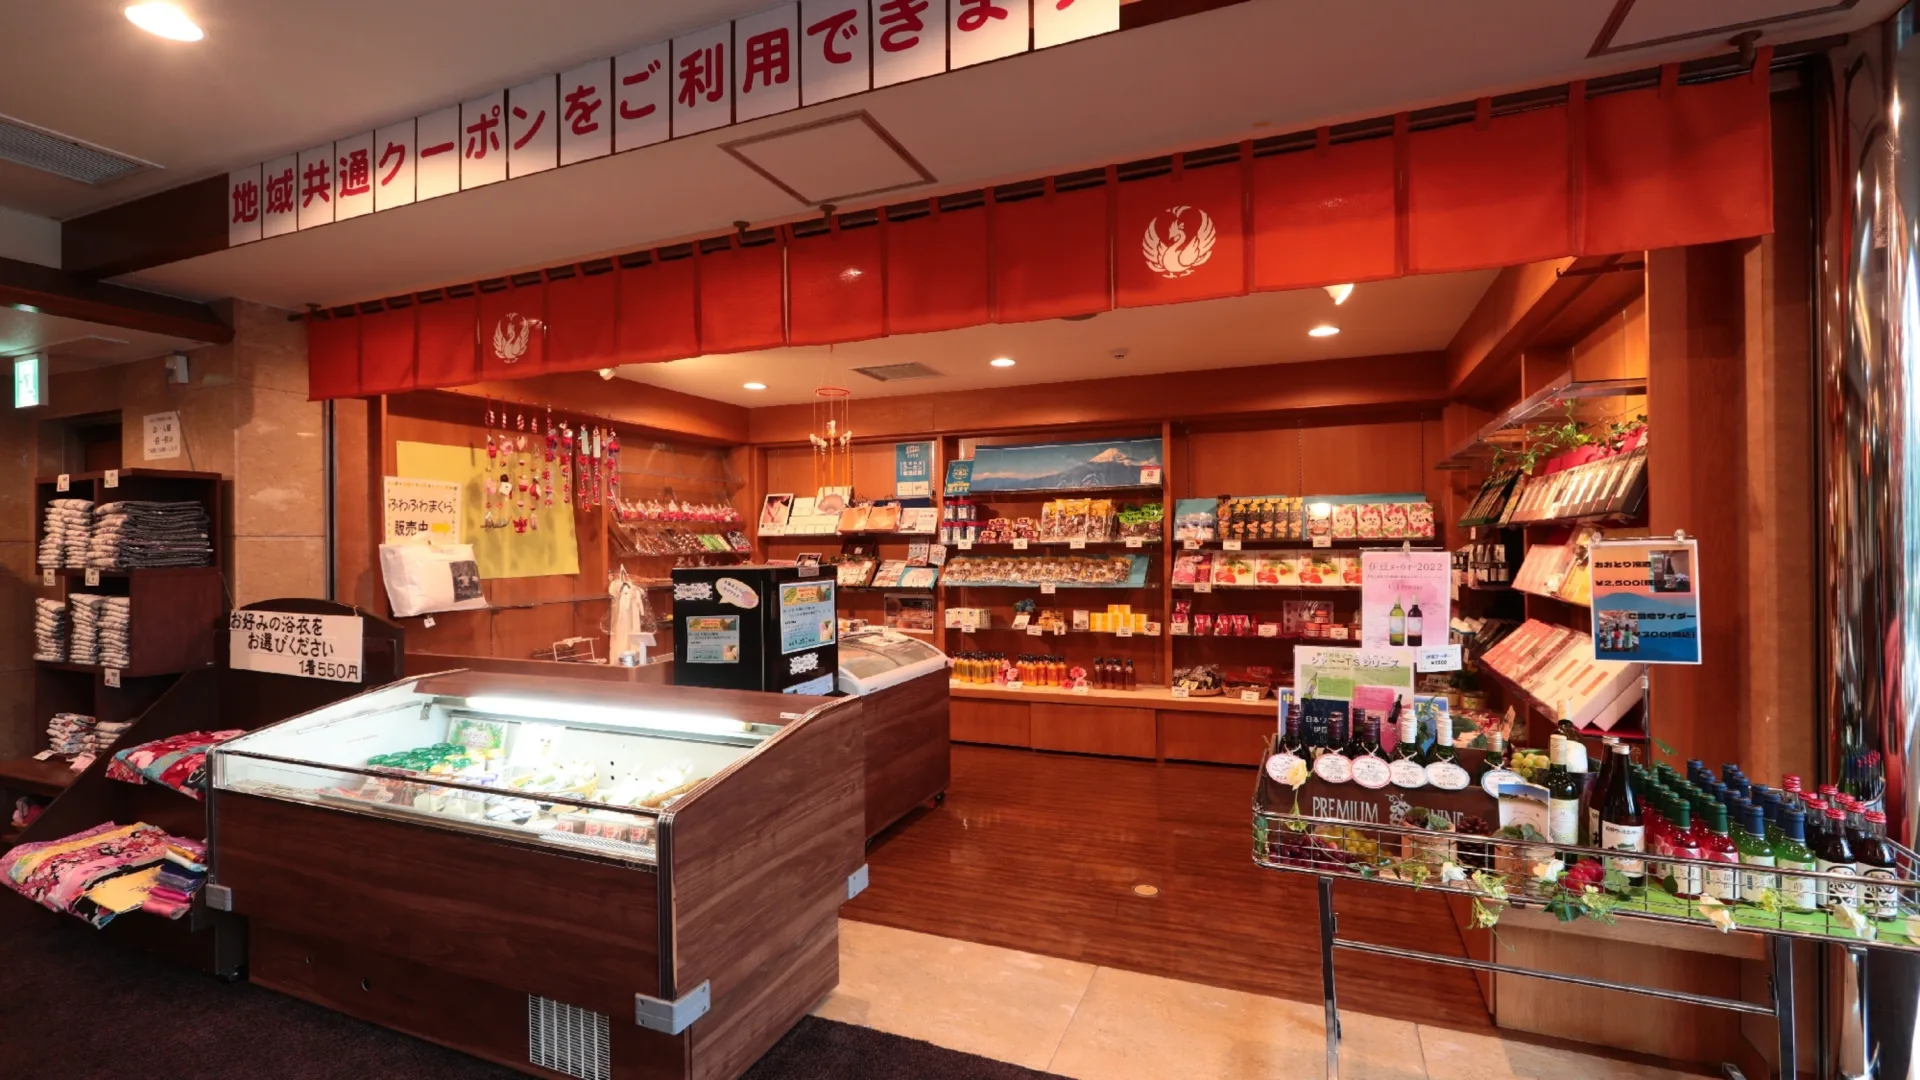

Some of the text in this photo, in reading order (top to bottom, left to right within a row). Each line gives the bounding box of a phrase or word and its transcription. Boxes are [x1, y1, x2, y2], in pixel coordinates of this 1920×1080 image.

[231, 0, 1076, 224] 地域共通クーポンをご利用できま
[387, 498, 454, 513] ふわふわまくら
[394, 520, 429, 537] 販売中
[230, 612, 323, 636] お好みの浴衣を
[247, 632, 334, 657] お選びください
[1312, 796, 1379, 824] PREMIUM
